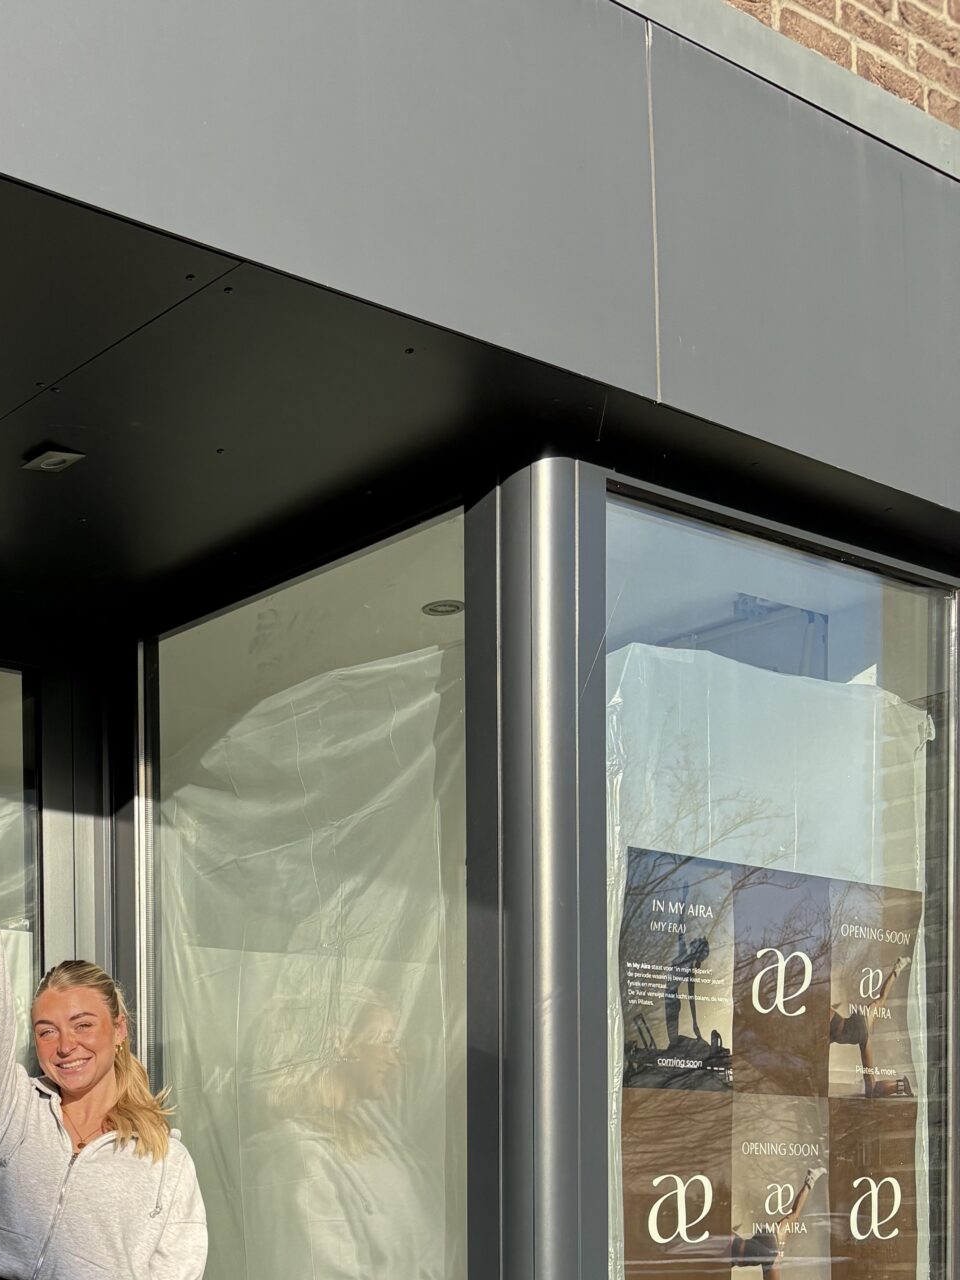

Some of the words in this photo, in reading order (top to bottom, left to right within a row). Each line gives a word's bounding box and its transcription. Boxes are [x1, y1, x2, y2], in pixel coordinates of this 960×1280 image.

[652, 899, 665, 913] IN
[669, 900, 685, 915] MY
[688, 903, 713, 919] AIRA
[650, 920, 669, 932] (MY
[669, 922, 686, 934] ERA)
[841, 924, 884, 942] OPENING
[886, 928, 910, 945] SOON
[849, 1003, 857, 1016] IN
[858, 1004, 871, 1017] MY
[872, 1005, 891, 1019] AIRA
[657, 1057, 685, 1068] coming
[686, 1060, 702, 1068] soon
[874, 1066, 880, 1075] &
[881, 1068, 897, 1076] more
[742, 1142, 787, 1156] OPENING
[789, 1143, 819, 1156] SOON
[752, 1222, 763, 1234] IN
[765, 1222, 781, 1234] MY
[784, 1222, 807, 1234] AIRA
